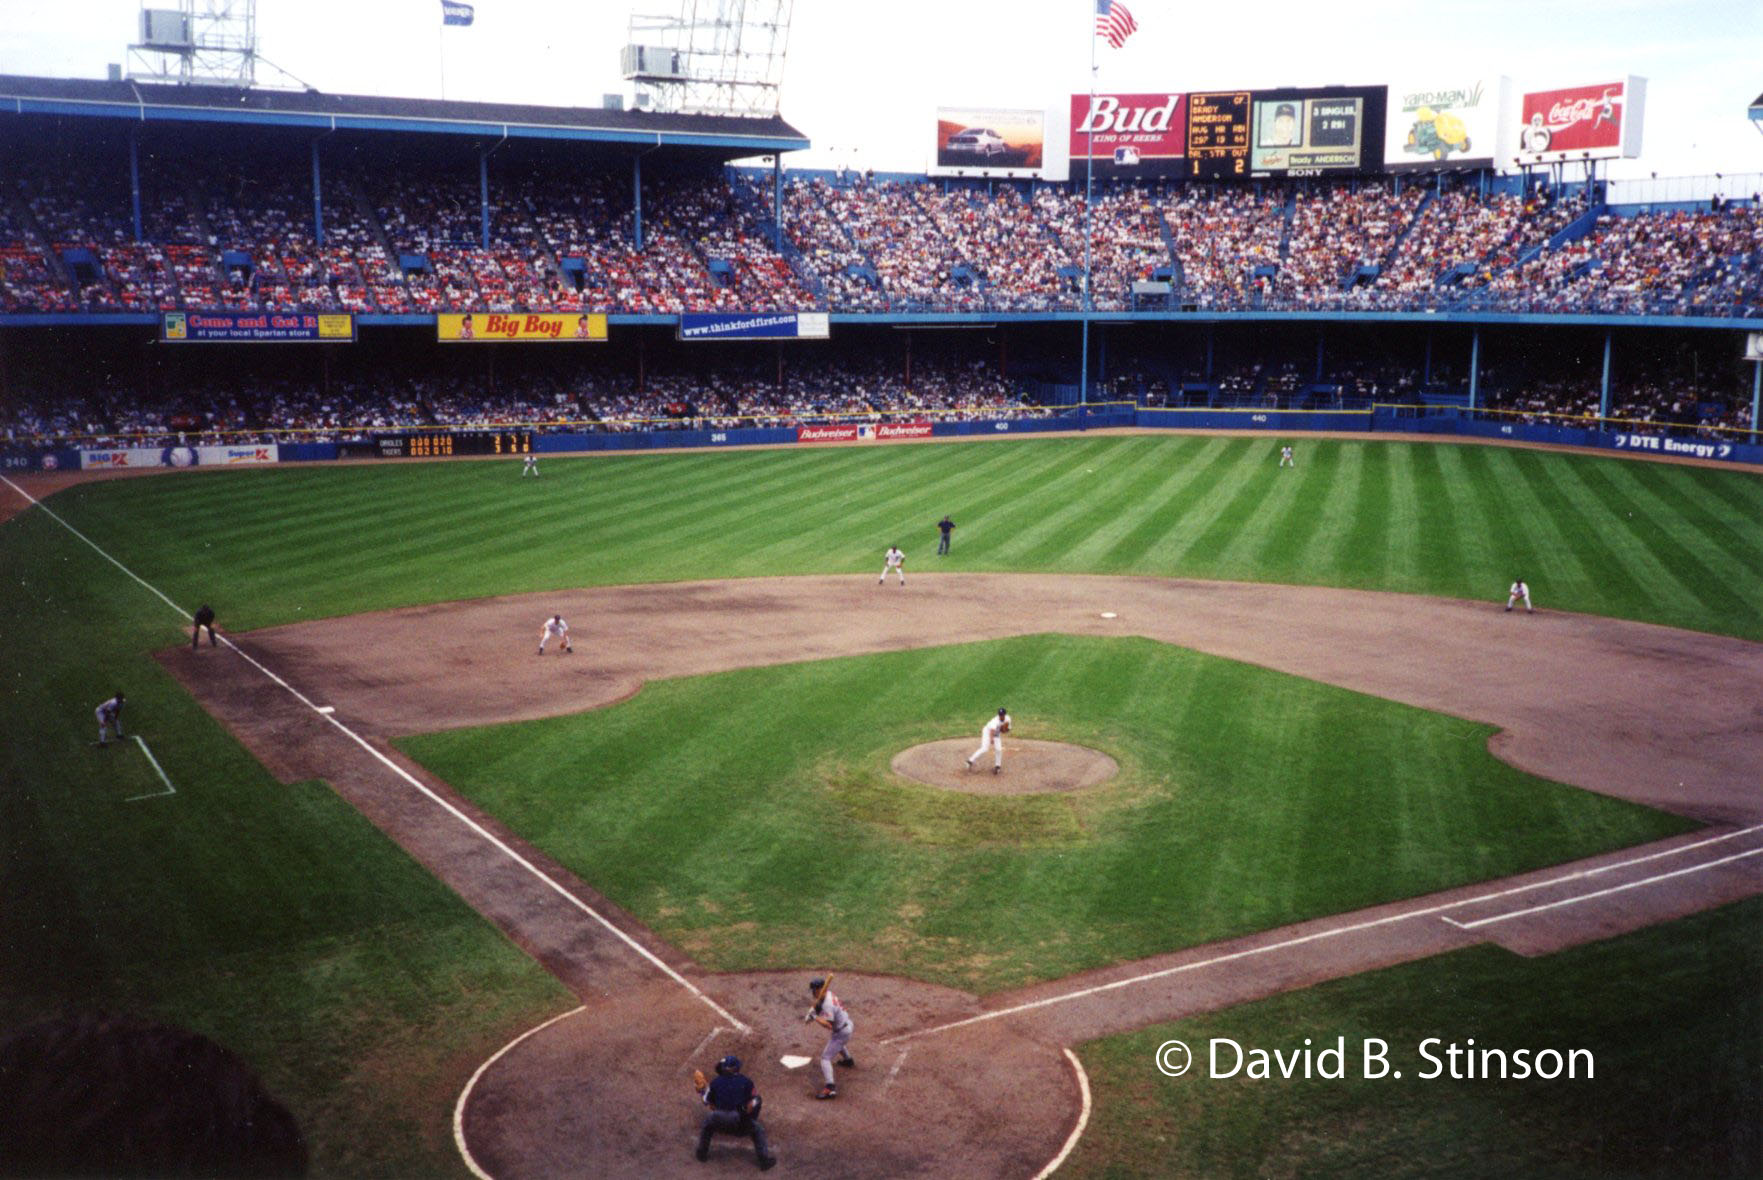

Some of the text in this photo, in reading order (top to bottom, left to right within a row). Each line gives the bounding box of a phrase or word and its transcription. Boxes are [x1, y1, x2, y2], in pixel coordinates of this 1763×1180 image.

[1075, 95, 1180, 133] Bud
[1192, 105, 1218, 114] BRADY
[1193, 159, 1244, 174] 1 2
[1287, 169, 1323, 177] SONY
[189, 315, 233, 328] Come
[237, 315, 267, 328] and
[272, 315, 299, 328] Get
[485, 314, 563, 338] Big Boy
[684, 315, 796, 336] www.thinkfordfirst.com
[209, 330, 228, 338] your
[254, 329, 285, 338] Spartan
[1252, 414, 1267, 422] 440
[801, 429, 855, 439] Budweiser
[879, 426, 931, 436] Budweiser
[1630, 435, 1714, 457] DTE Energy
